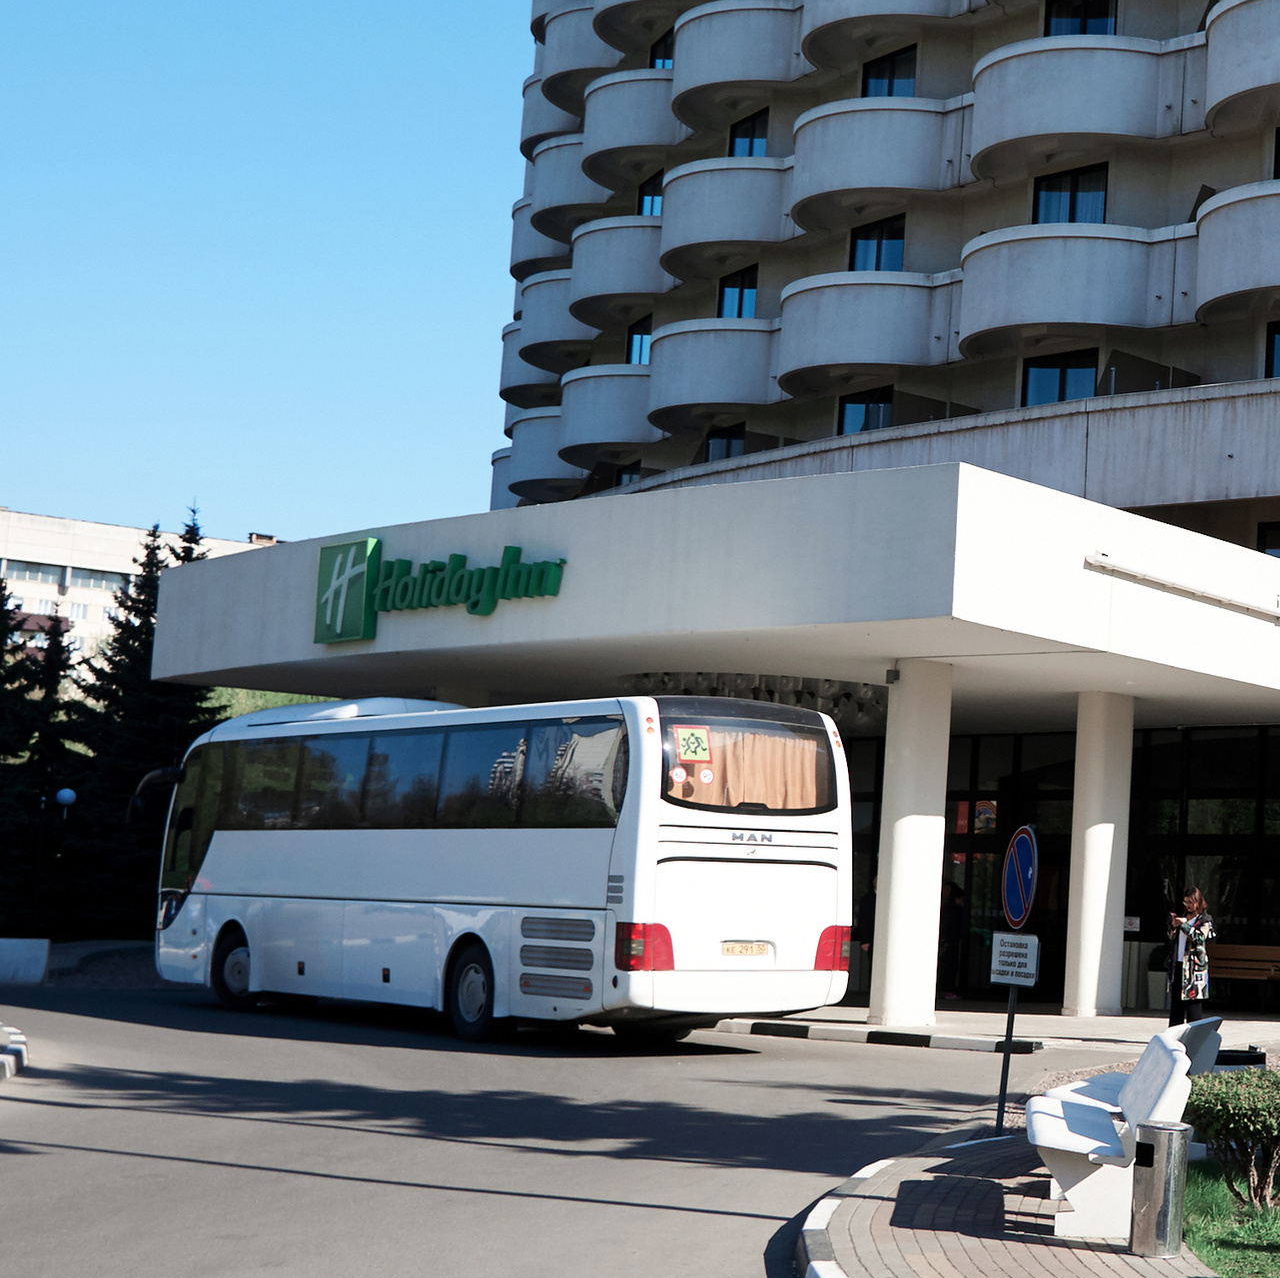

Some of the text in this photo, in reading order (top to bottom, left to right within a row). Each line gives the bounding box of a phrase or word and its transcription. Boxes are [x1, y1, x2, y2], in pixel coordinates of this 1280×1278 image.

[373, 546, 563, 616] Holiday Inn
[731, 832, 773, 843] MAN
